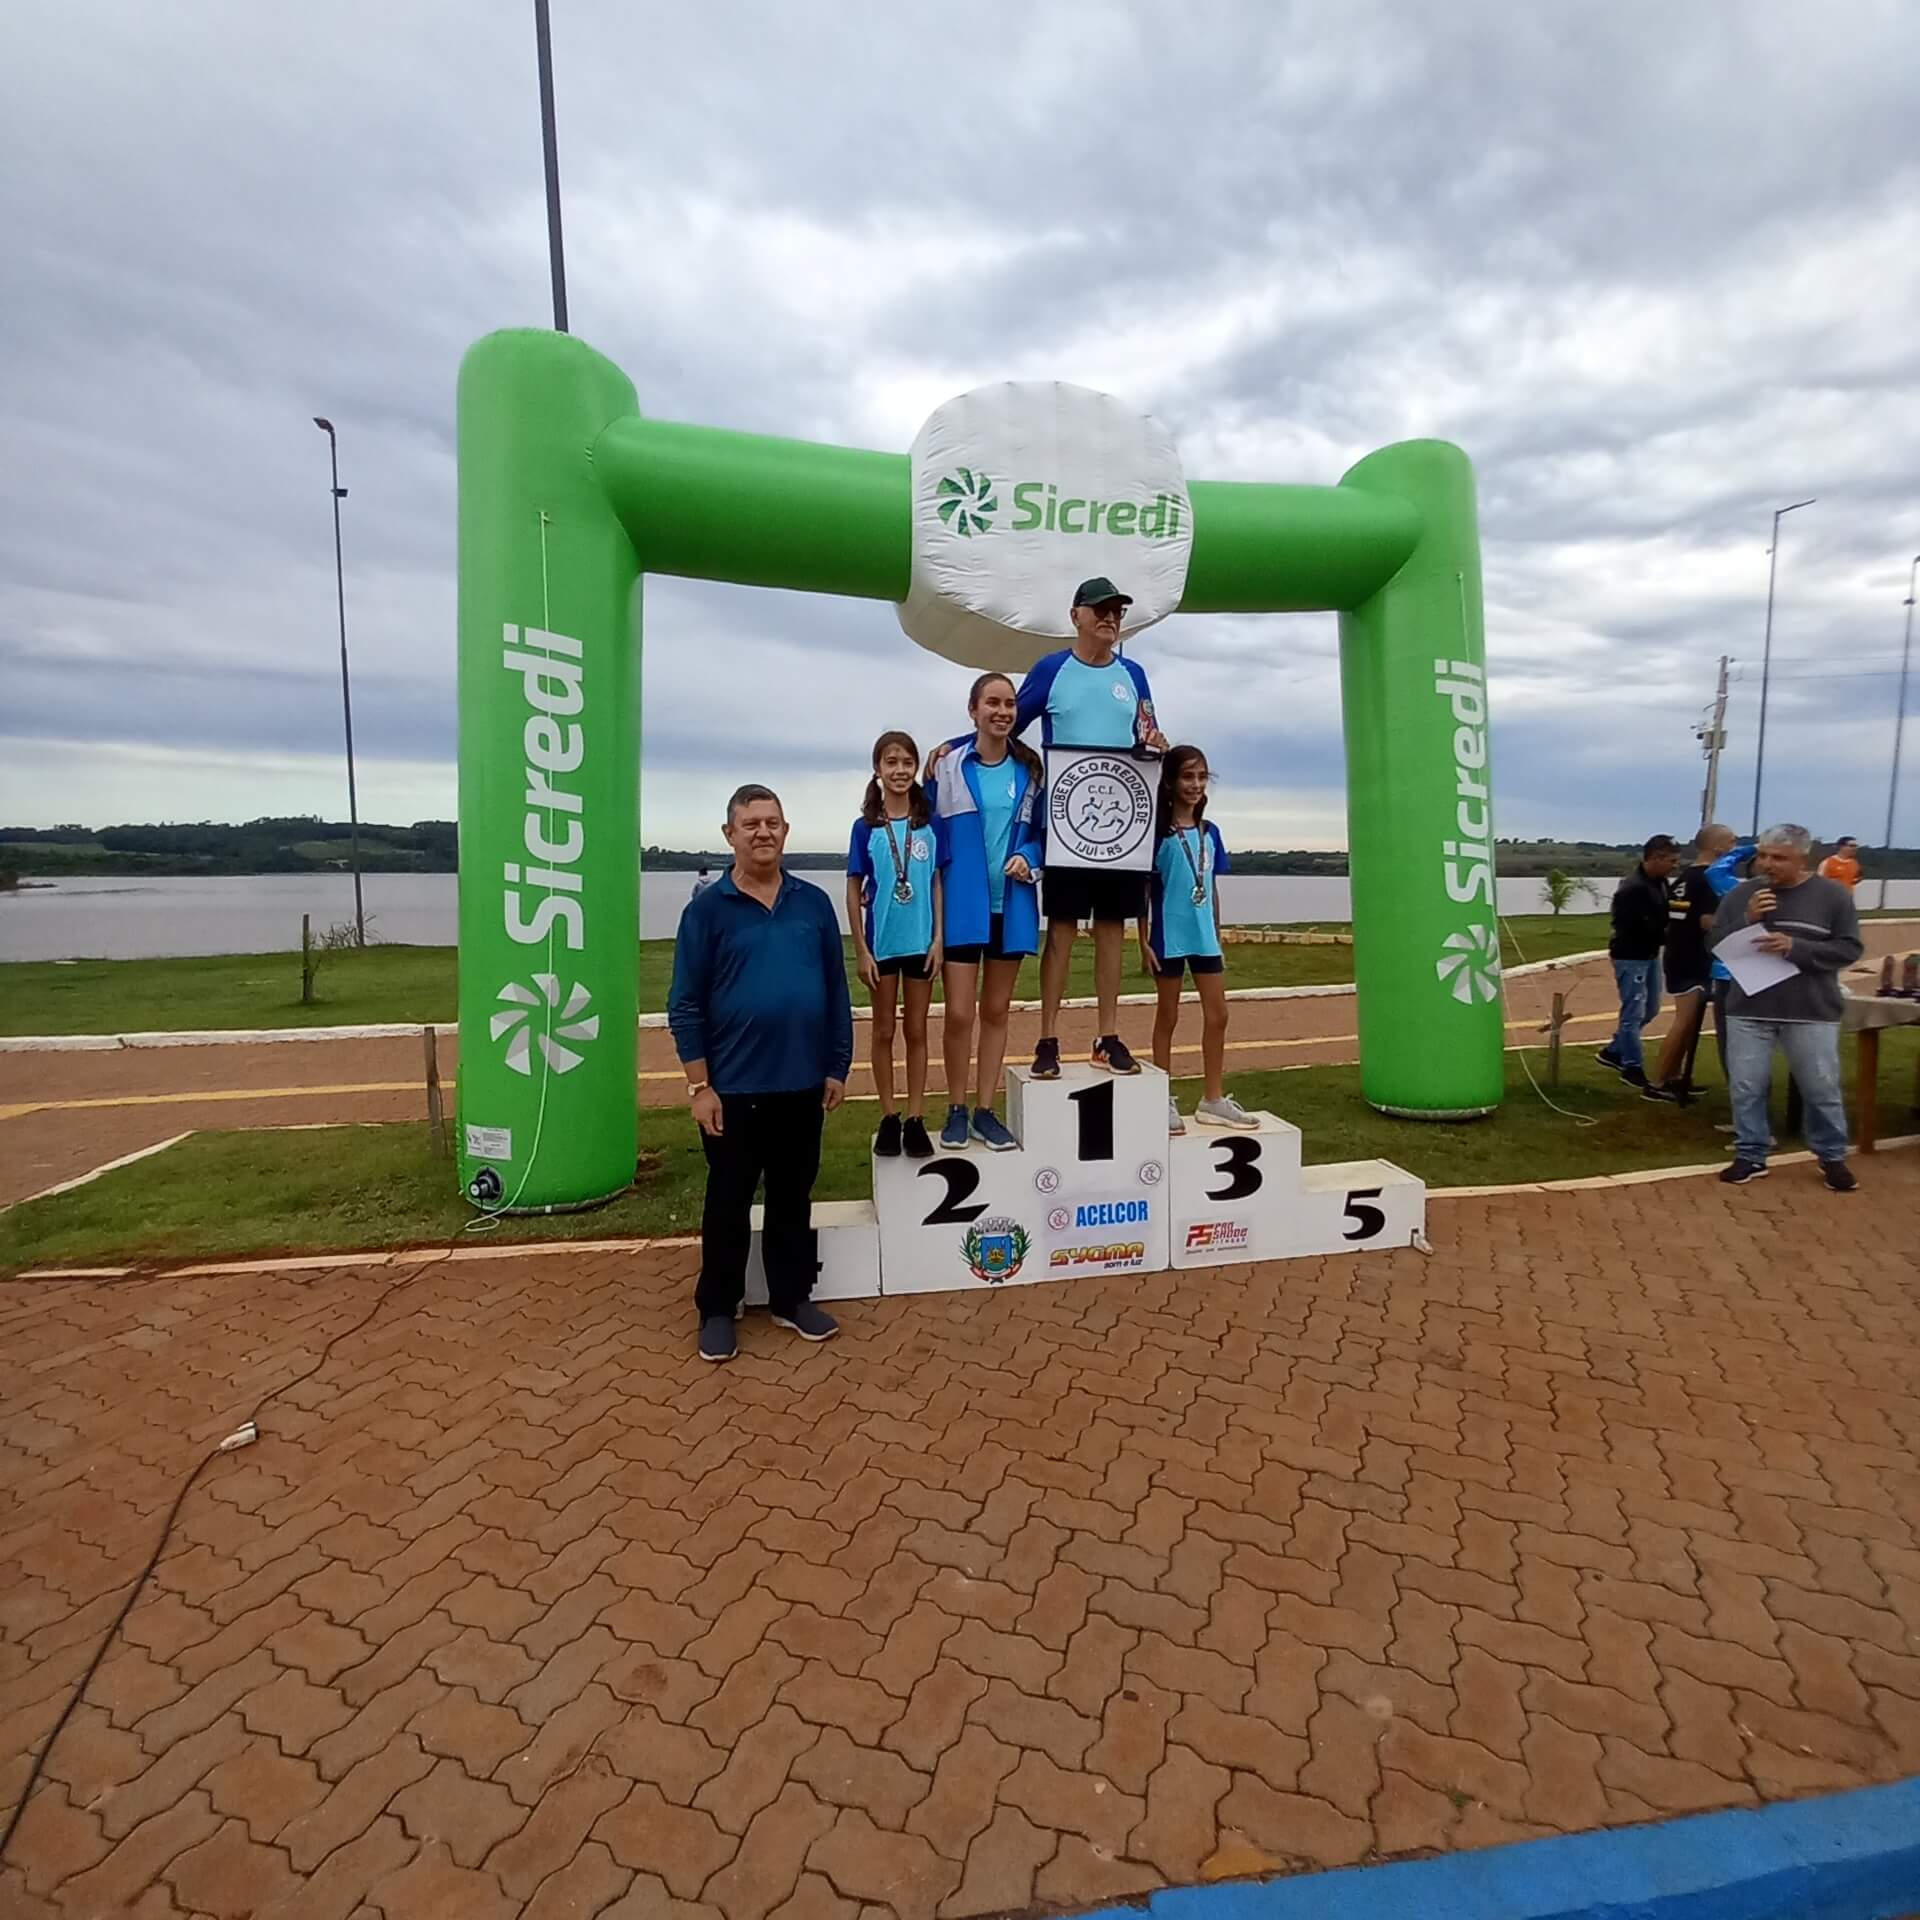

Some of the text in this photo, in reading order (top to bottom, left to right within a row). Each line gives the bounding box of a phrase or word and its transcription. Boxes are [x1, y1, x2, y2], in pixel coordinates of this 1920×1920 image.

[1012, 483, 1180, 538] Sicredi
[503, 623, 584, 950] Sicredi
[1053, 788, 1068, 820] CLUBE
[1062, 772, 1079, 787] DE
[1078, 761, 1148, 809] CORREDORES
[1135, 812, 1148, 825] DE
[1434, 658, 1494, 907] Sicredi
[1106, 843, 1122, 857] RS
[1068, 1079, 1115, 1161] 1
[916, 1157, 990, 1226] 2
[1204, 1135, 1264, 1201] 3
[1075, 1199, 1149, 1228] ACELCOR
[1341, 1187, 1386, 1241] 5
